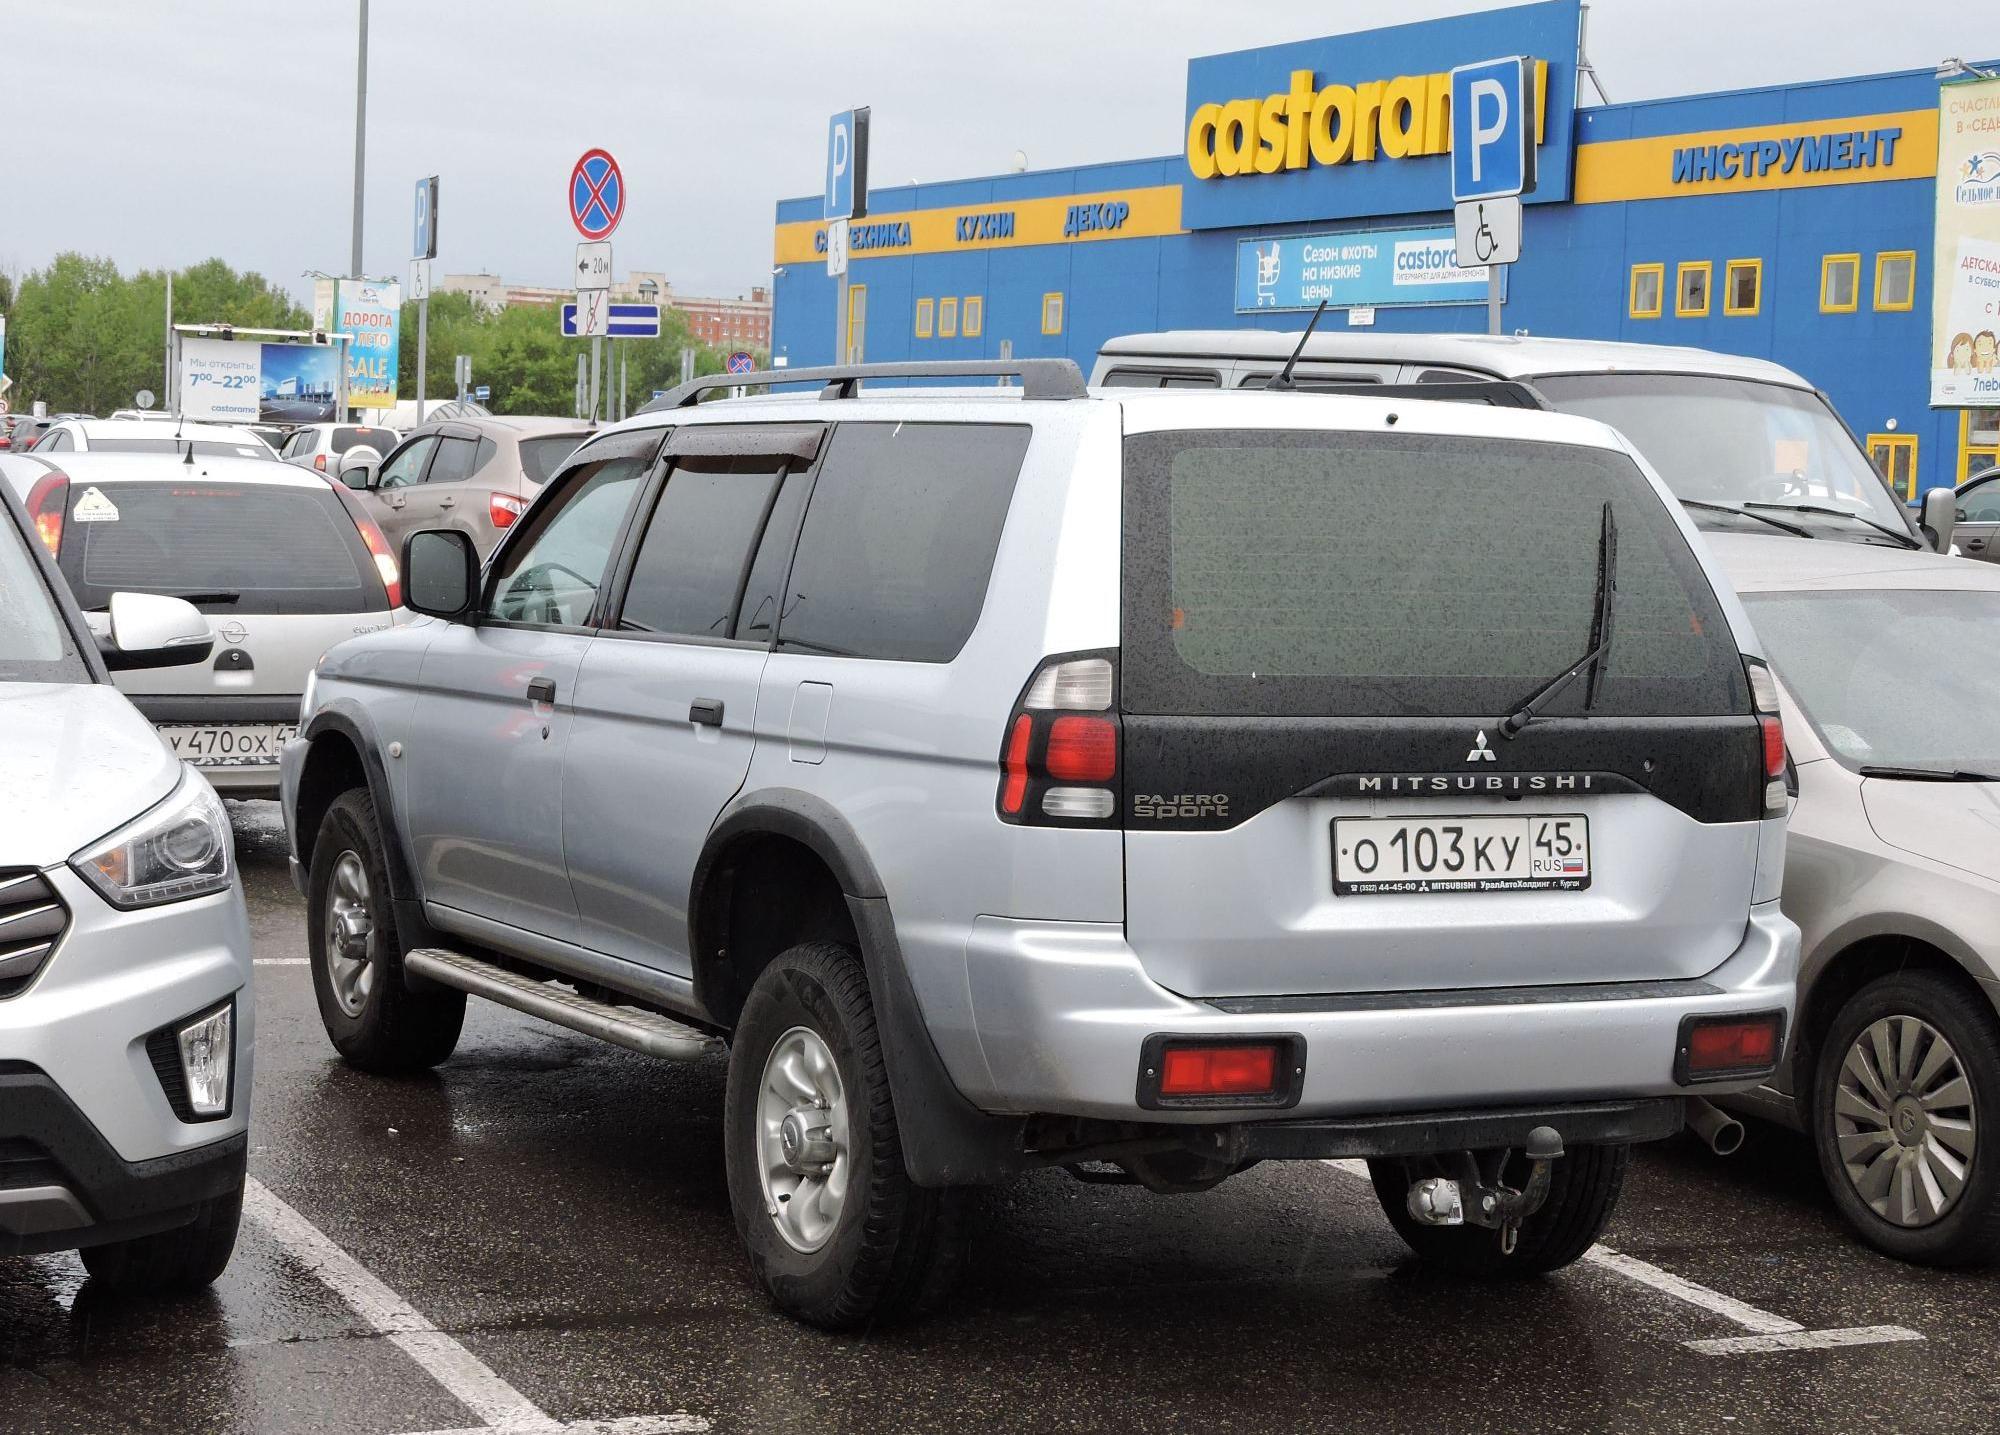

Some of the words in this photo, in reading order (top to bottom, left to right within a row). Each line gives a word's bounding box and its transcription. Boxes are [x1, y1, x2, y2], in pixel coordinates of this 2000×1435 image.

[1187, 60, 1548, 180] castora
[1956, 120, 1964, 134] В
[1470, 79, 1508, 182] P
[1671, 127, 1902, 183] ИНСТРУМЕНТ
[831, 123, 848, 207] P
[417, 187, 426, 250] P
[956, 211, 1015, 242] КУХНИ
[1063, 200, 1129, 238] ДЕКОР
[1303, 244, 1339, 263] Сезон
[1341, 244, 1378, 260] охоты
[1397, 246, 1457, 270] castora
[1302, 266, 1318, 281] на
[1320, 263, 1362, 280] низкие
[1960, 256, 2000, 273] ДЕТСКА
[1301, 284, 1333, 302] цены
[343, 311, 392, 328] ДОРОГА
[358, 331, 389, 348] ЛЕТО
[189, 358, 207, 369] Мы
[211, 404, 257, 414] castorama
[1359, 775, 1592, 791] MITSUBISHI
[1134, 793, 1230, 805] PAJERO
[1535, 822, 1573, 857] 45
[1533, 859, 1562, 872] RUS
[1378, 882, 1417, 892] 44-45-00
[1431, 881, 1477, 890] MITSUBISHI
[1480, 880, 1550, 890] УралАвтоХолдинг
[1560, 879, 1581, 889] Курган
